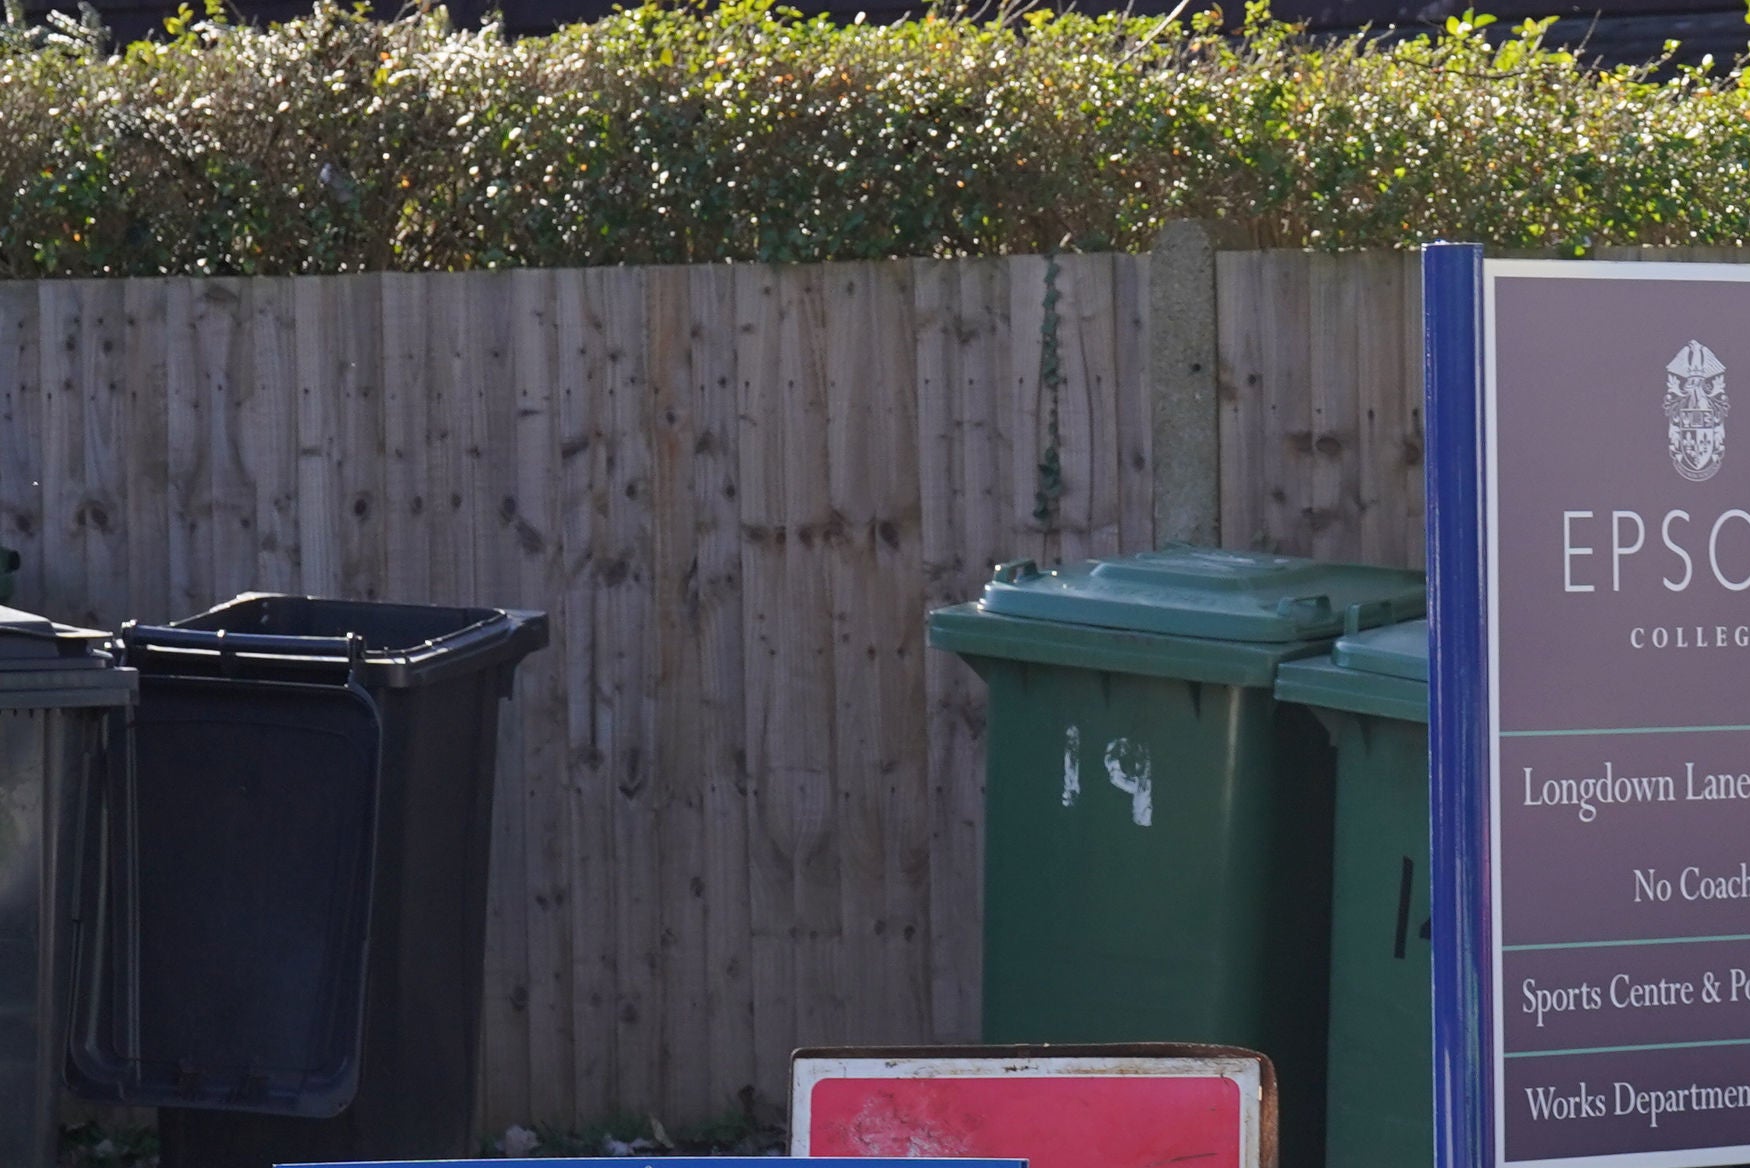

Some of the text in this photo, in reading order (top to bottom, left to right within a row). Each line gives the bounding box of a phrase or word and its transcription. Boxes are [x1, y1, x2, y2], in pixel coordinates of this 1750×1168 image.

[1523, 762, 1676, 822] Longdown
[1633, 868, 1672, 902] No
[1522, 975, 1602, 1027] Sports
[1609, 973, 1694, 1009] Centre
[1701, 972, 1722, 1003] &
[1525, 1081, 1607, 1121] Works
